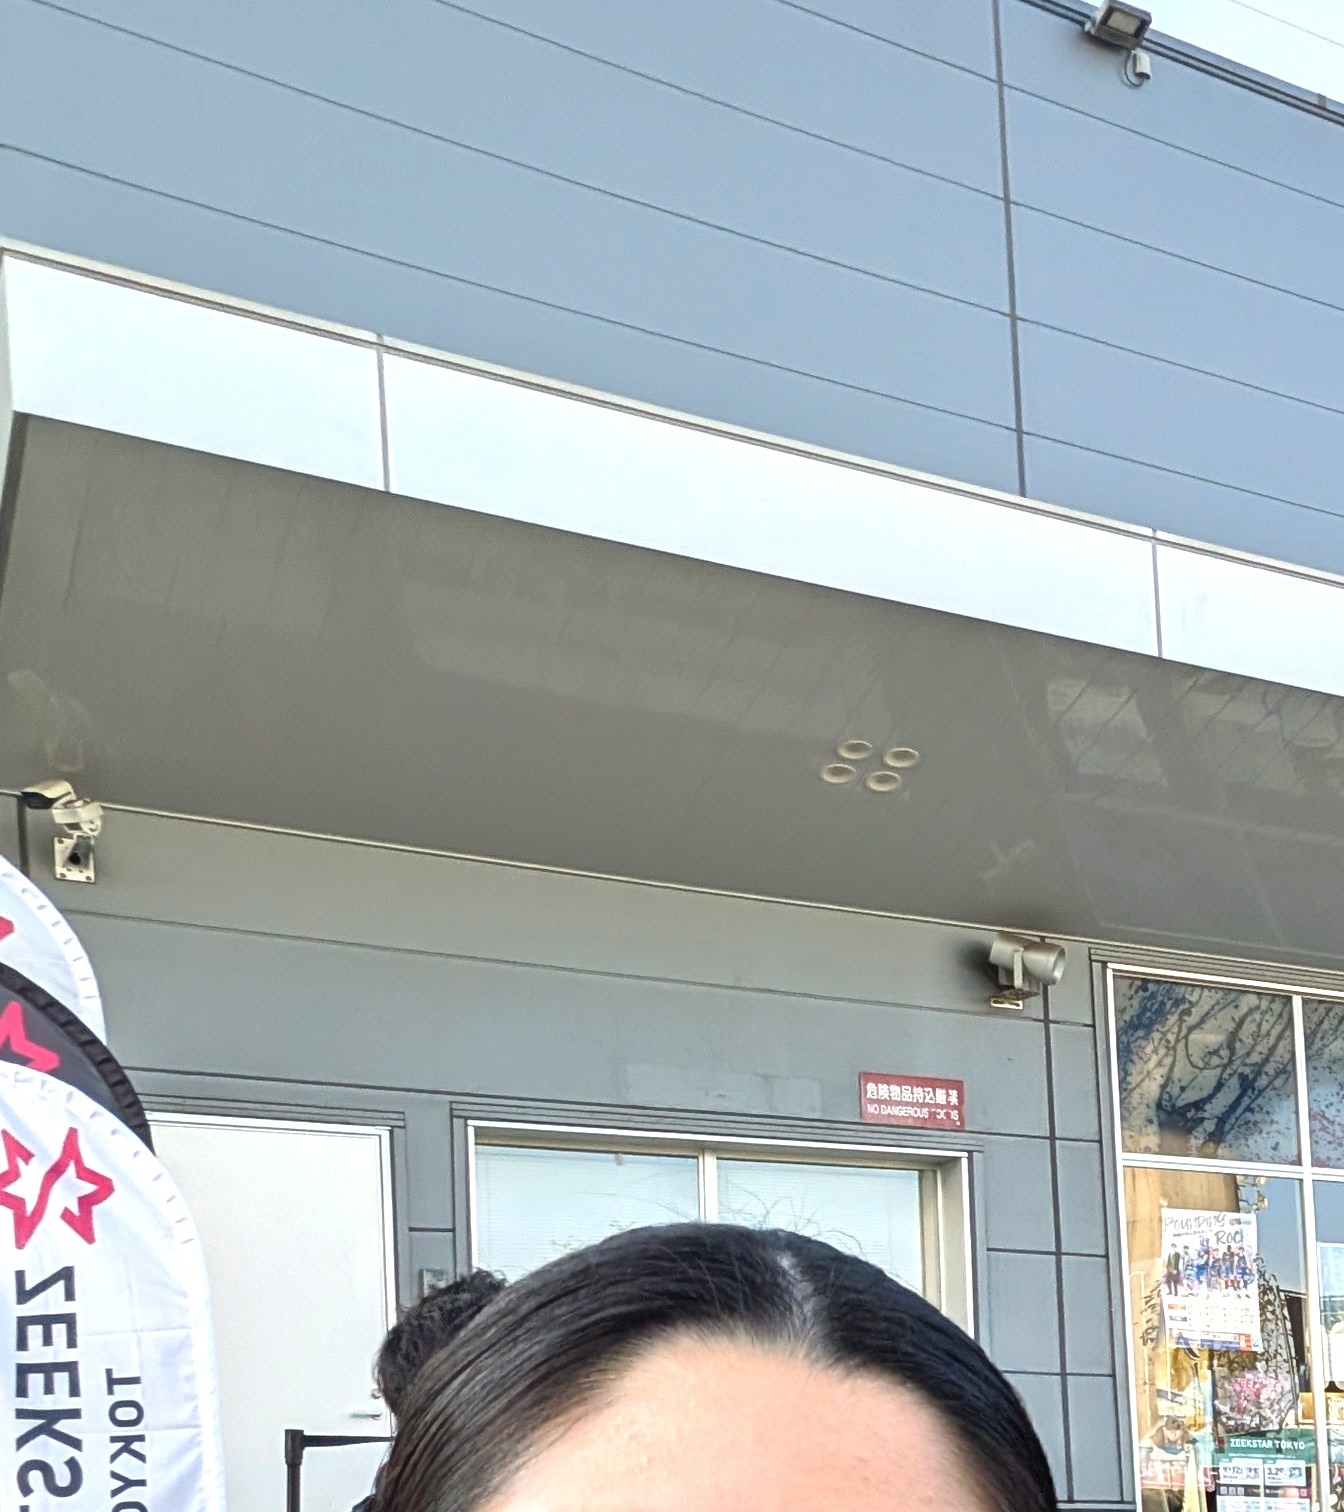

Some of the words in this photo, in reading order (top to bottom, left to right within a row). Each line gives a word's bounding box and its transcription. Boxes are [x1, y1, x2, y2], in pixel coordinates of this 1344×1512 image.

[867, 1103, 879, 1115] NO
[881, 1104, 929, 1119] DANGEROUS
[1230, 1438, 1273, 1448] ZEEKSTAR
[1274, 1440, 1306, 1450] TOKYO
